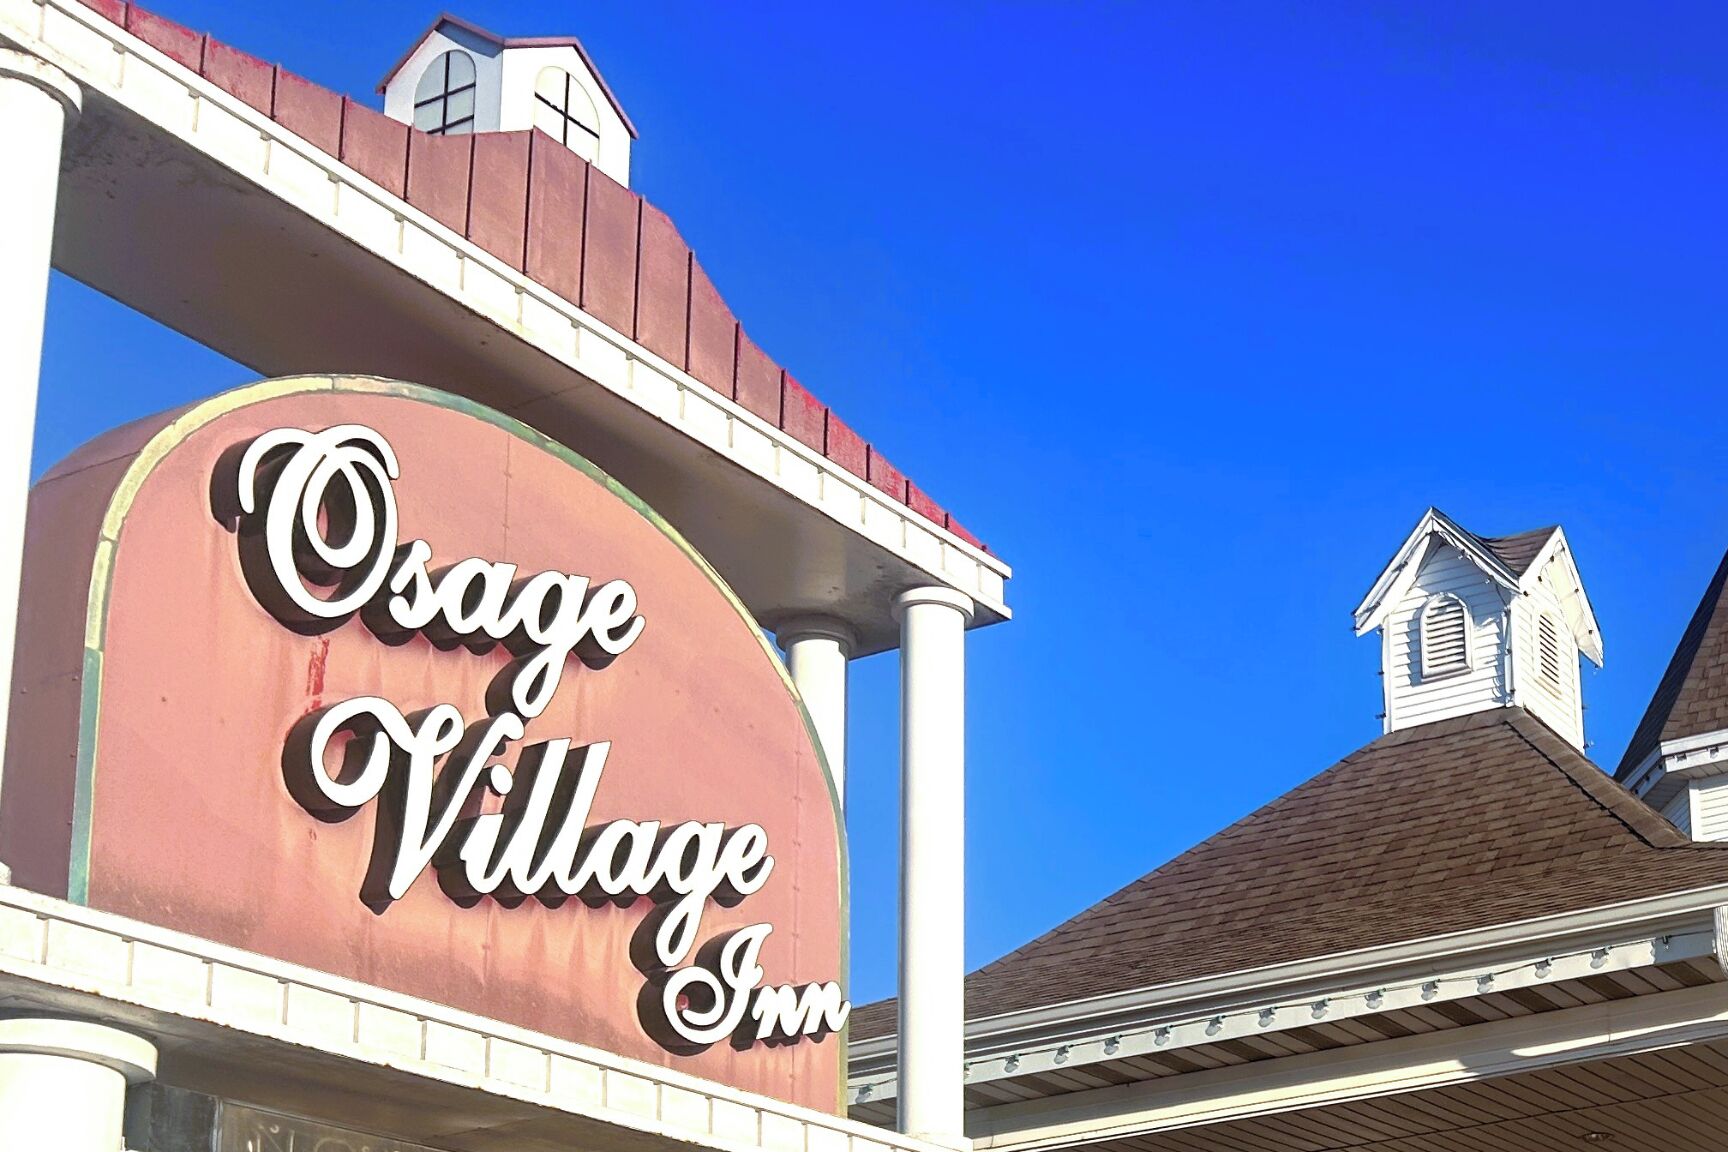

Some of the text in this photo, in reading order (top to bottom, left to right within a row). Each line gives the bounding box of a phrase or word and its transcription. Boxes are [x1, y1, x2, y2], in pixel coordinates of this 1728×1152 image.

[230, 424, 645, 719] Osage
[306, 695, 774, 966] Village
[658, 922, 851, 1045] Inn
